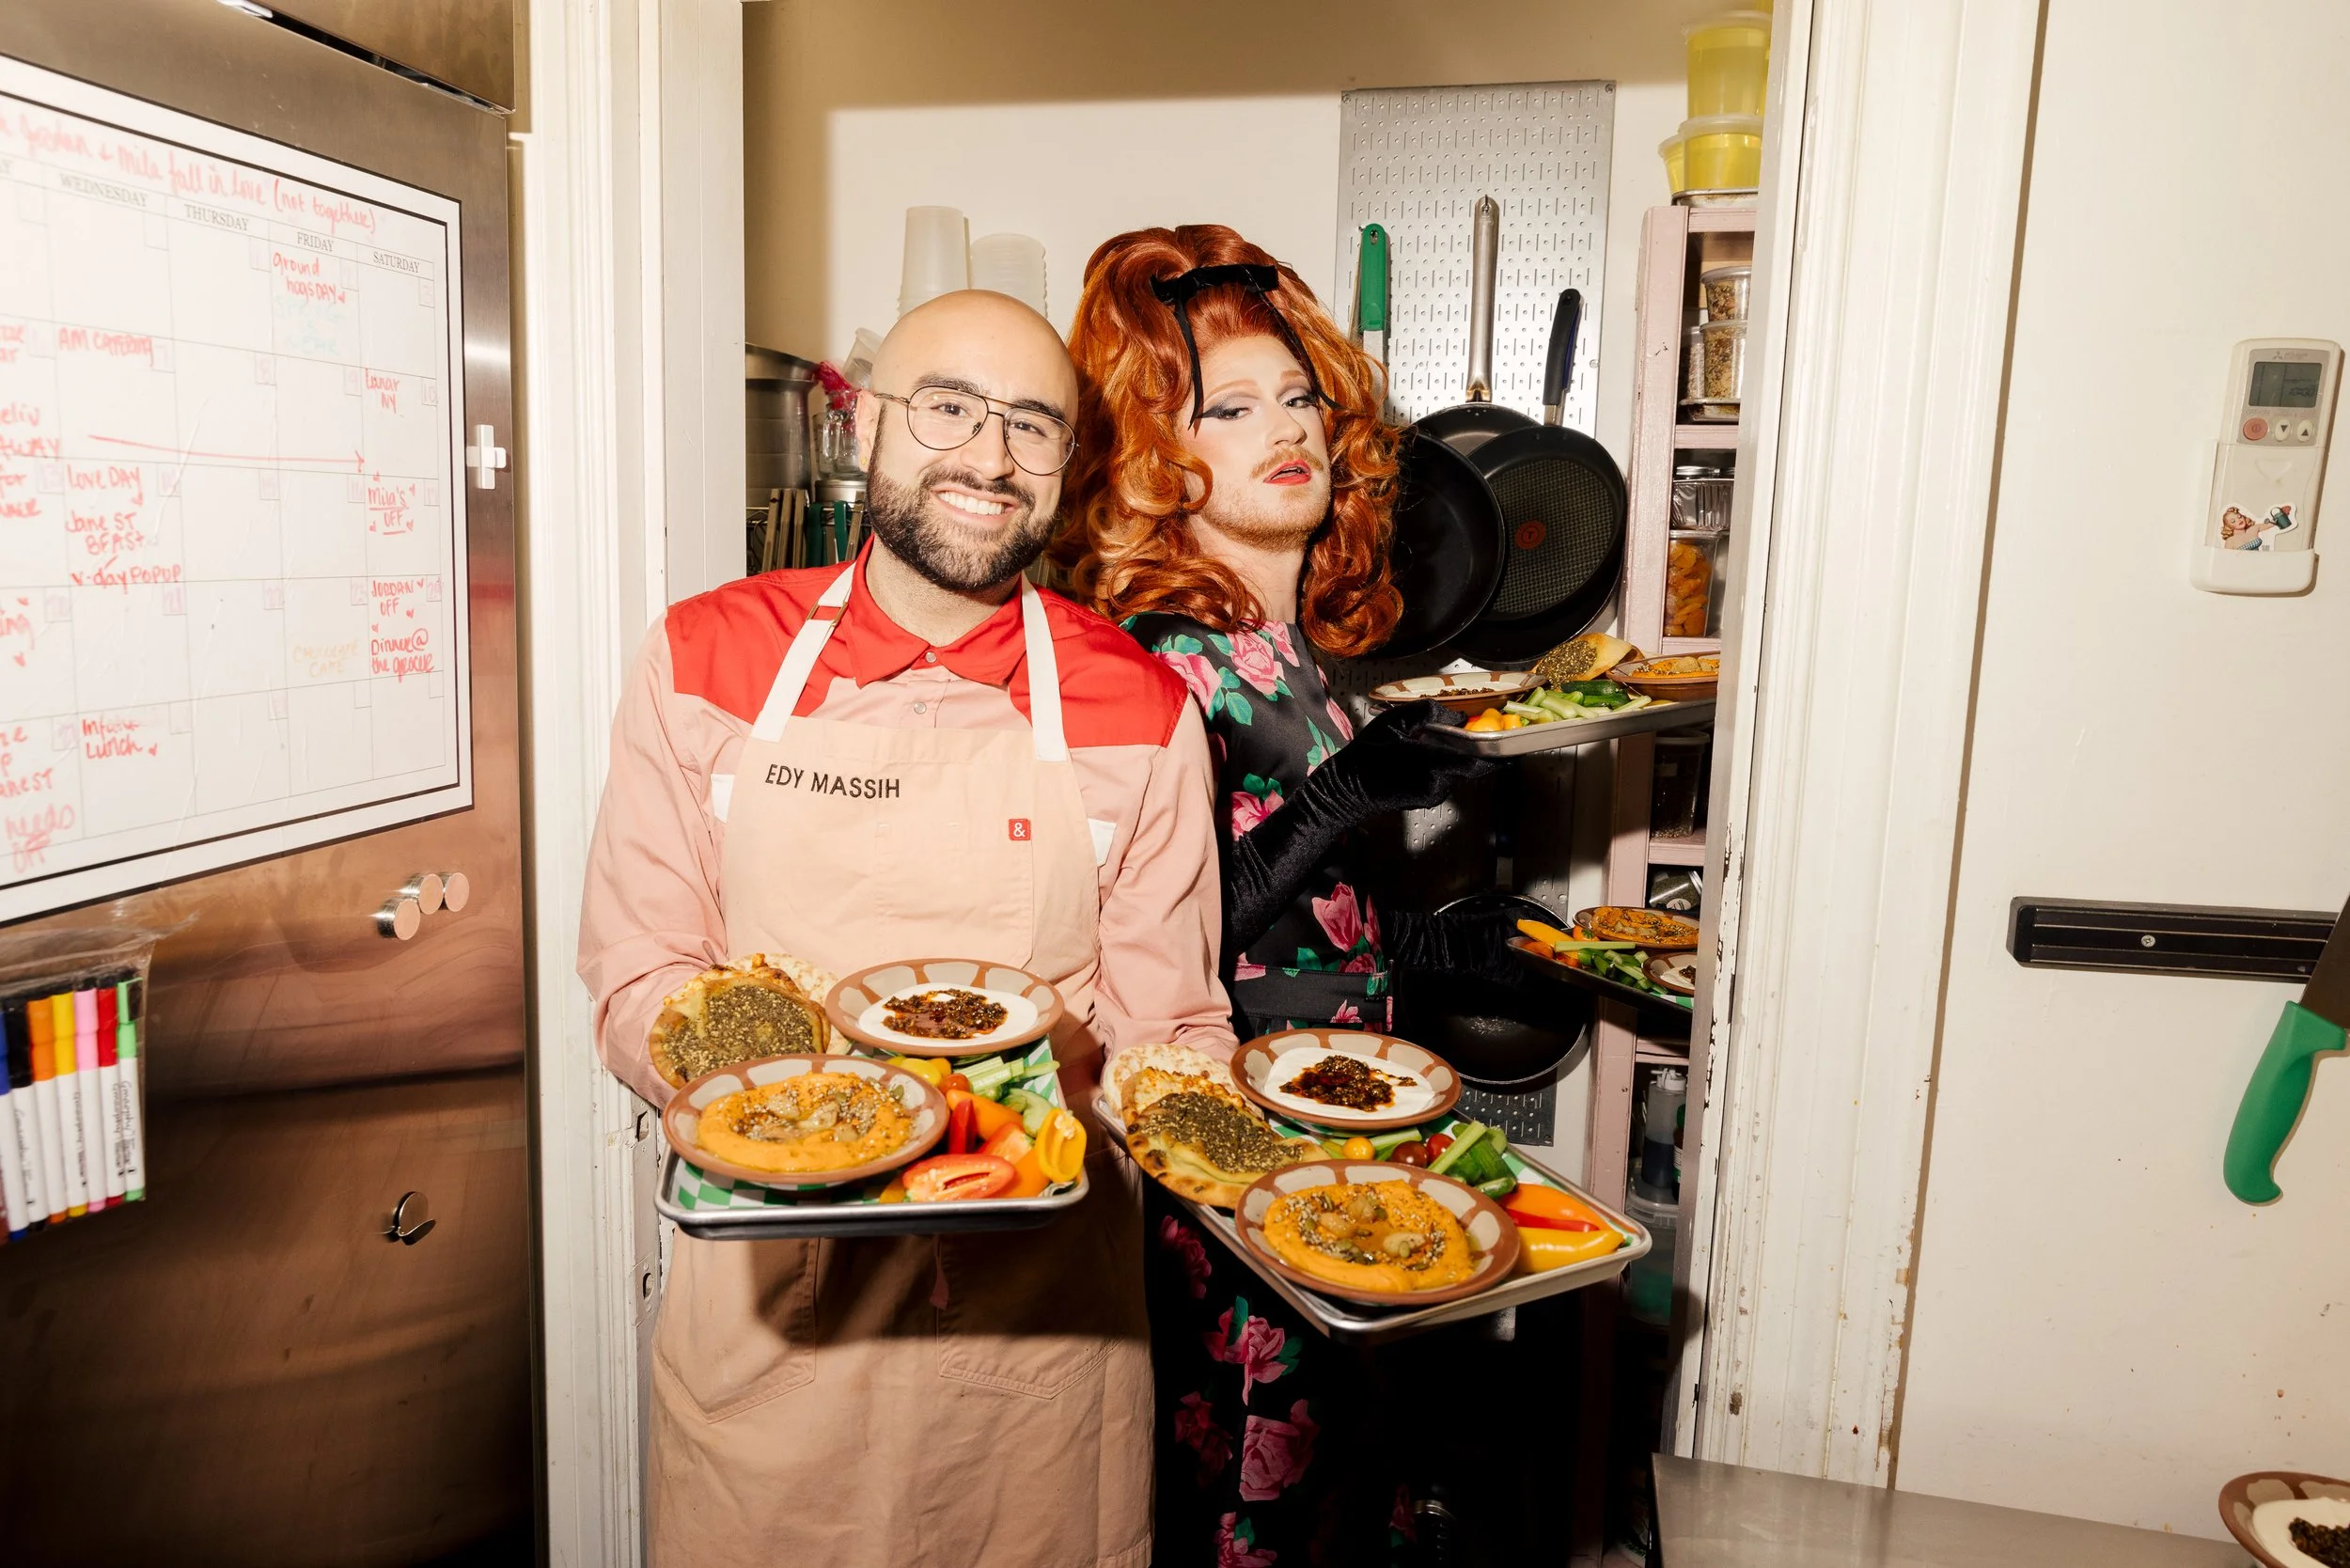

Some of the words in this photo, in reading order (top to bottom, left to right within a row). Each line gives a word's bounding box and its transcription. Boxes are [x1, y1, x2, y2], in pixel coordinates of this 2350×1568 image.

[59, 174, 149, 208] WEDNESDAY
[184, 203, 249, 231] THURSDAY
[297, 232, 335, 252] FRIDAY
[272, 252, 321, 276] ground
[373, 251, 420, 274] SATURDAY
[58, 326, 90, 352] AM
[381, 391, 397, 414] NY
[383, 510, 404, 527] OFF
[371, 579, 415, 598] JORDAN
[380, 598, 400, 618] OFF
[764, 762, 805, 790] EDY
[810, 771, 901, 800] MASSIH
[1012, 822, 1026, 839] &
